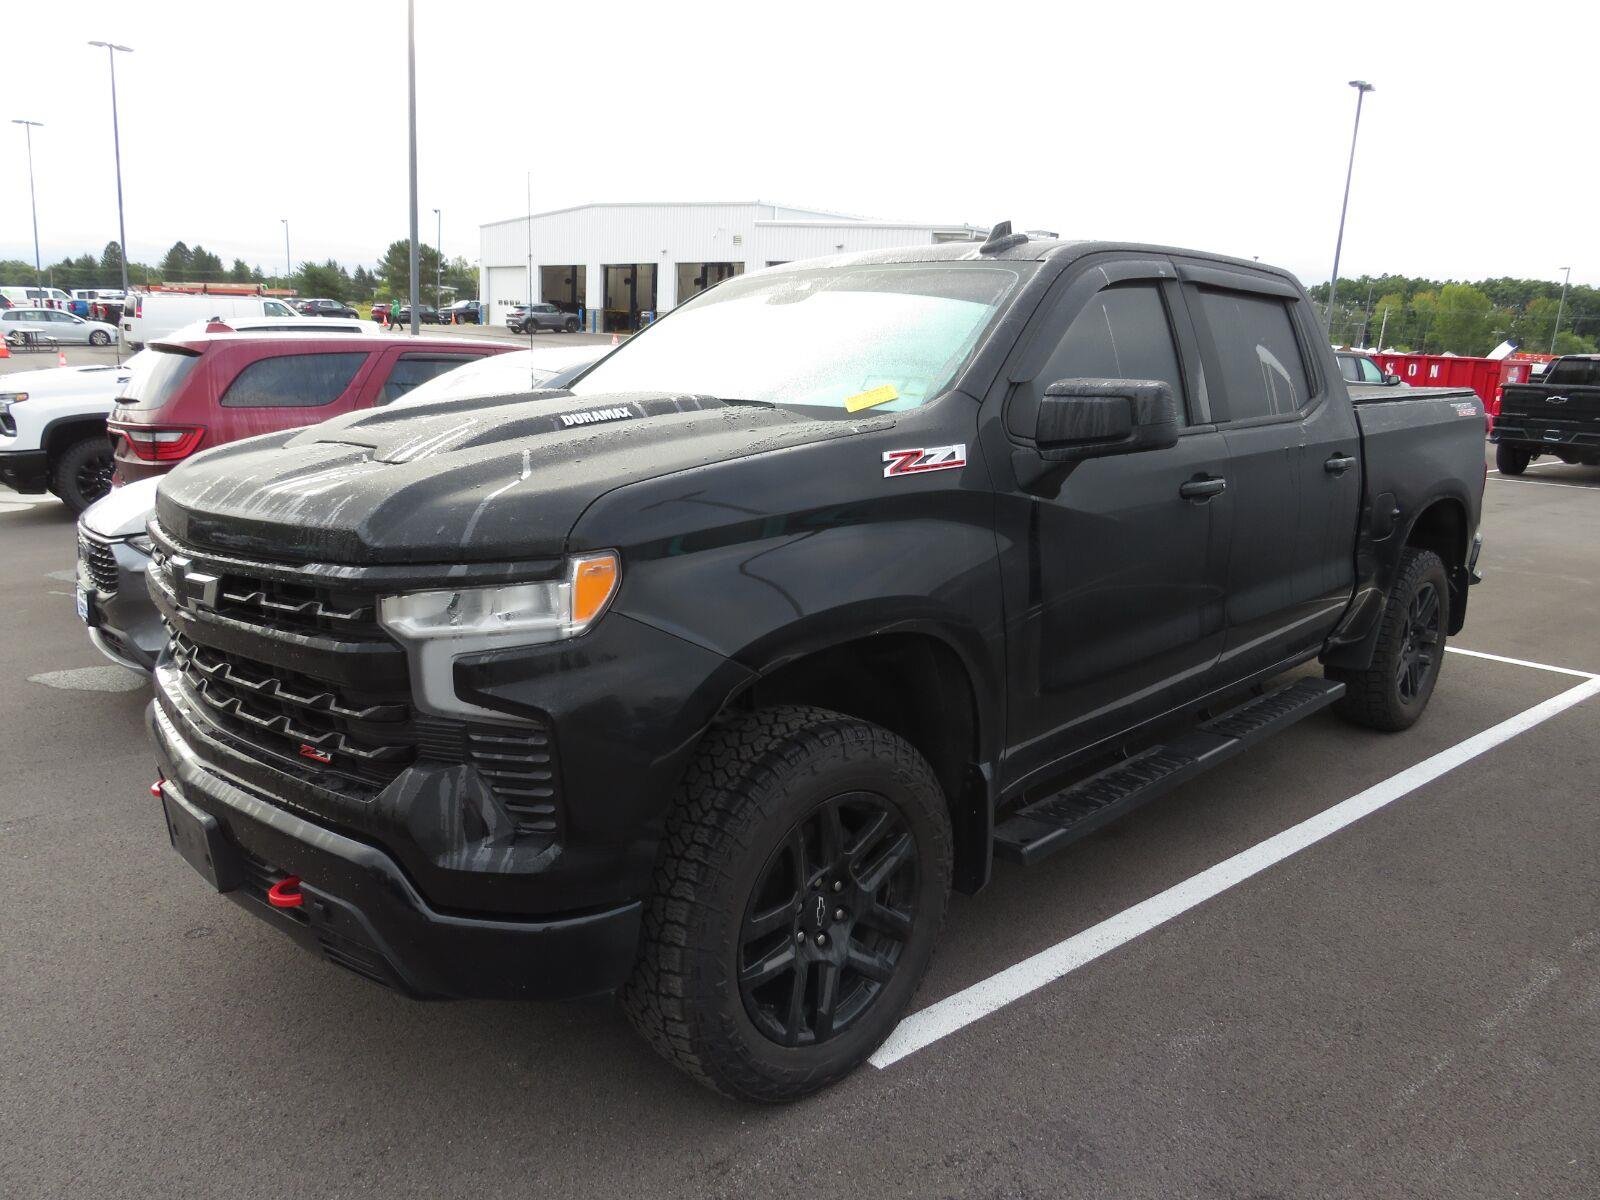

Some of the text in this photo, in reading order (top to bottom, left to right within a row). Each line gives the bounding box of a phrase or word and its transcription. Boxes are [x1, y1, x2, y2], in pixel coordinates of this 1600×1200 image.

[560, 407, 633, 427] DURAMAX
[882, 443, 967, 478] Z71
[299, 743, 332, 764] Z71
